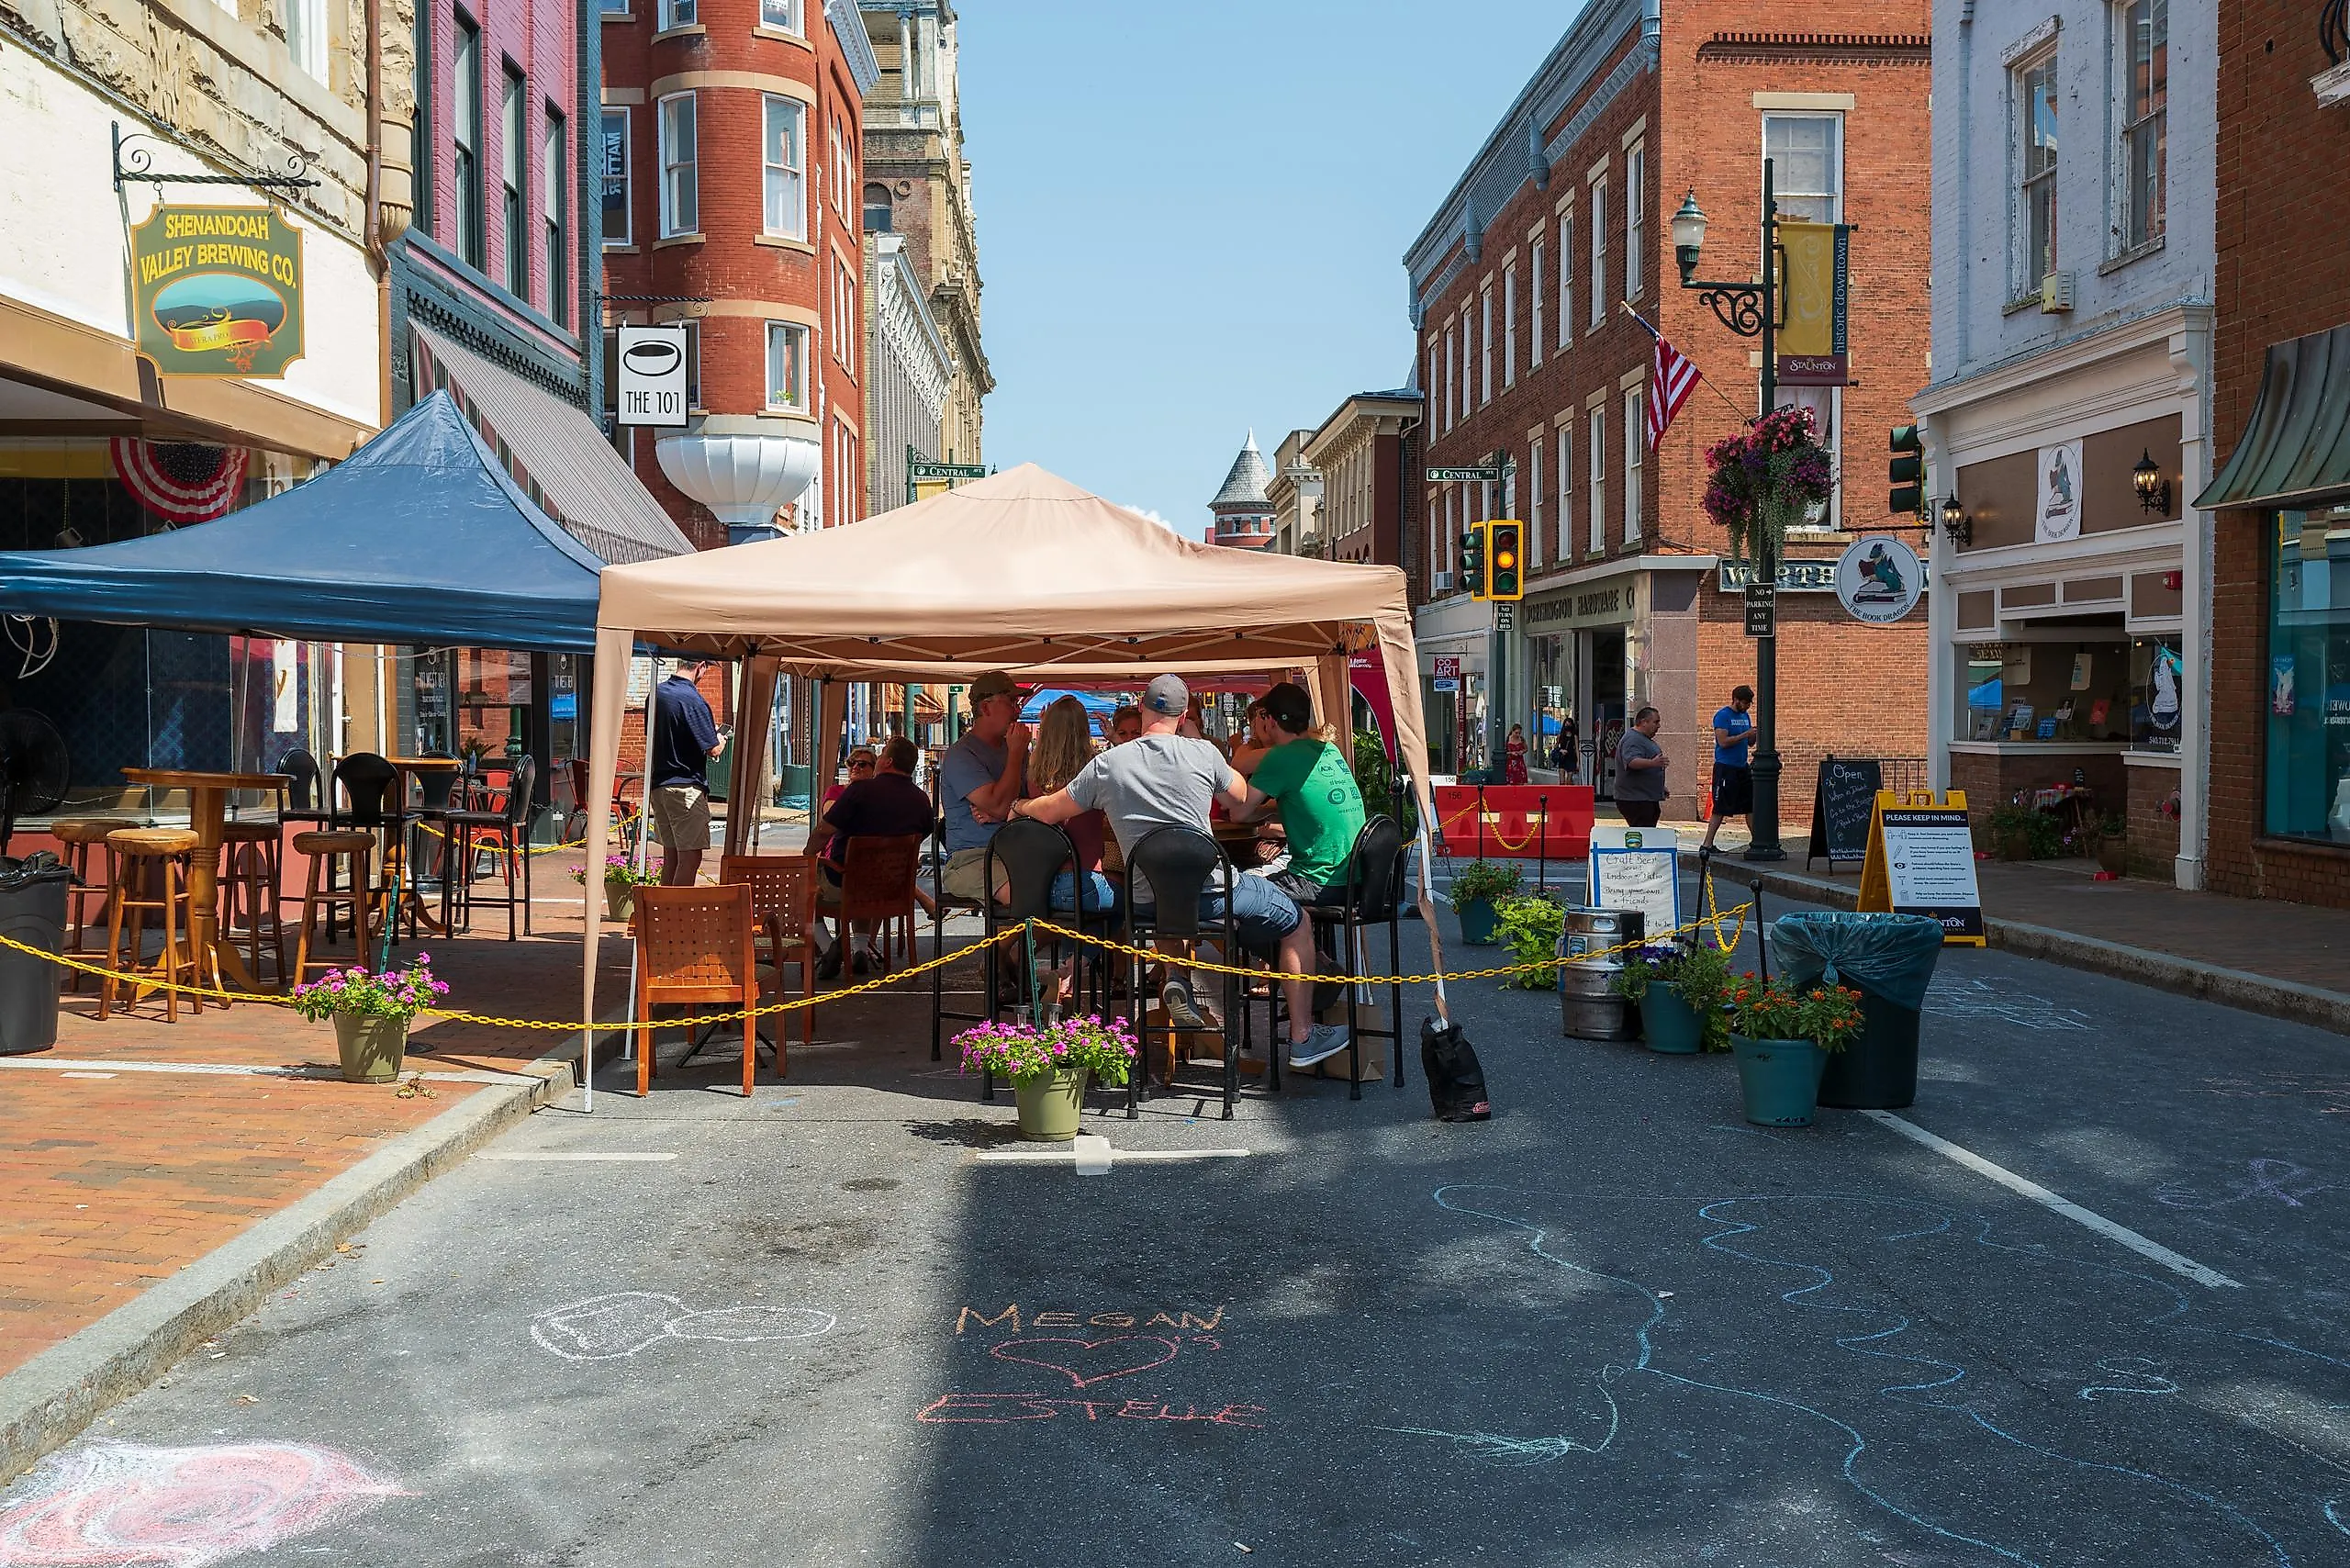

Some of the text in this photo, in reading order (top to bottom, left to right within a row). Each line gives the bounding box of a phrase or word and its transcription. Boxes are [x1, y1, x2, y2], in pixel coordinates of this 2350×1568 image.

[165, 214, 269, 241] SHENANDOAH
[140, 243, 297, 289] VALLEY BREWING CO.
[1834, 238, 1847, 353] historic downtown
[1790, 359, 1837, 372] STAUNTON
[626, 391, 679, 414] THE 101
[930, 467, 969, 477] CENTRAL
[1442, 470, 1482, 479] CENTRAL
[1849, 602, 1910, 622] THE BOOK DRAGON
[1436, 666, 1458, 677] ART
[1438, 658, 1451, 666] CO
[1833, 764, 1864, 783] Open
[1606, 852, 1657, 865] Craft Beer
[956, 1304, 1225, 1335] MEGAN
